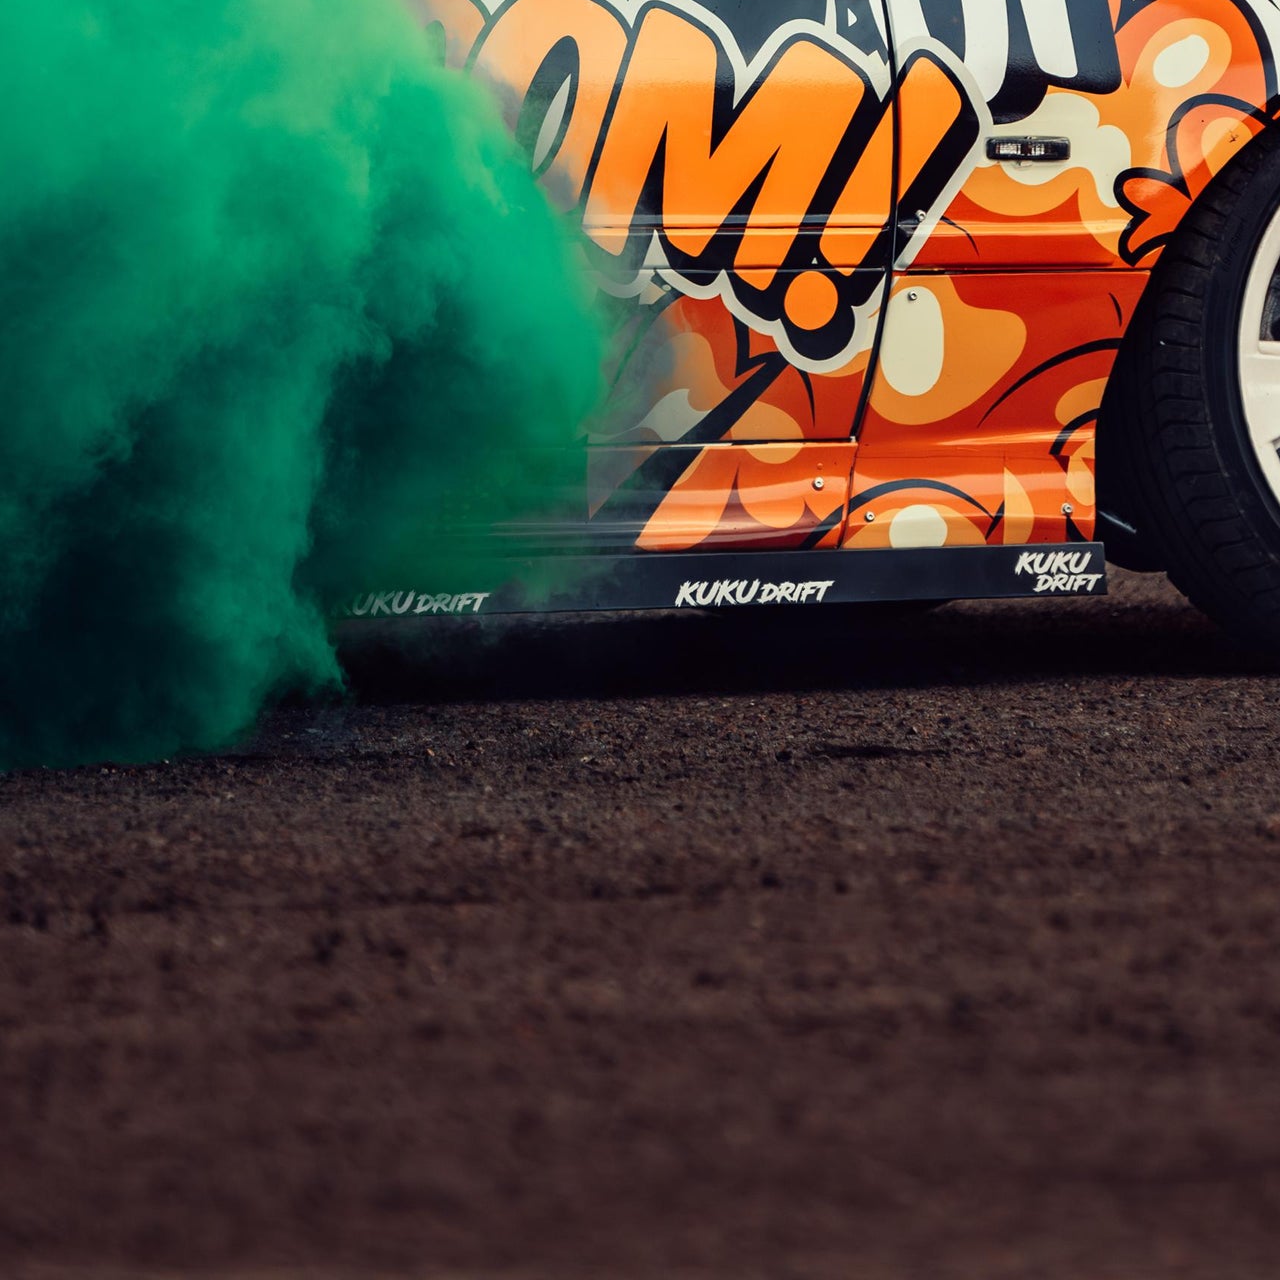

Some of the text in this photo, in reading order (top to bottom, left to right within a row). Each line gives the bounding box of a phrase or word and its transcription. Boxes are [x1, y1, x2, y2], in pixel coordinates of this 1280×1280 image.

[1014, 551, 1093, 576] KUKU
[674, 578, 836, 607] KUKU DRIFT
[1032, 573, 1103, 593] DRIFT
[338, 589, 491, 616] UKU DRIFT
